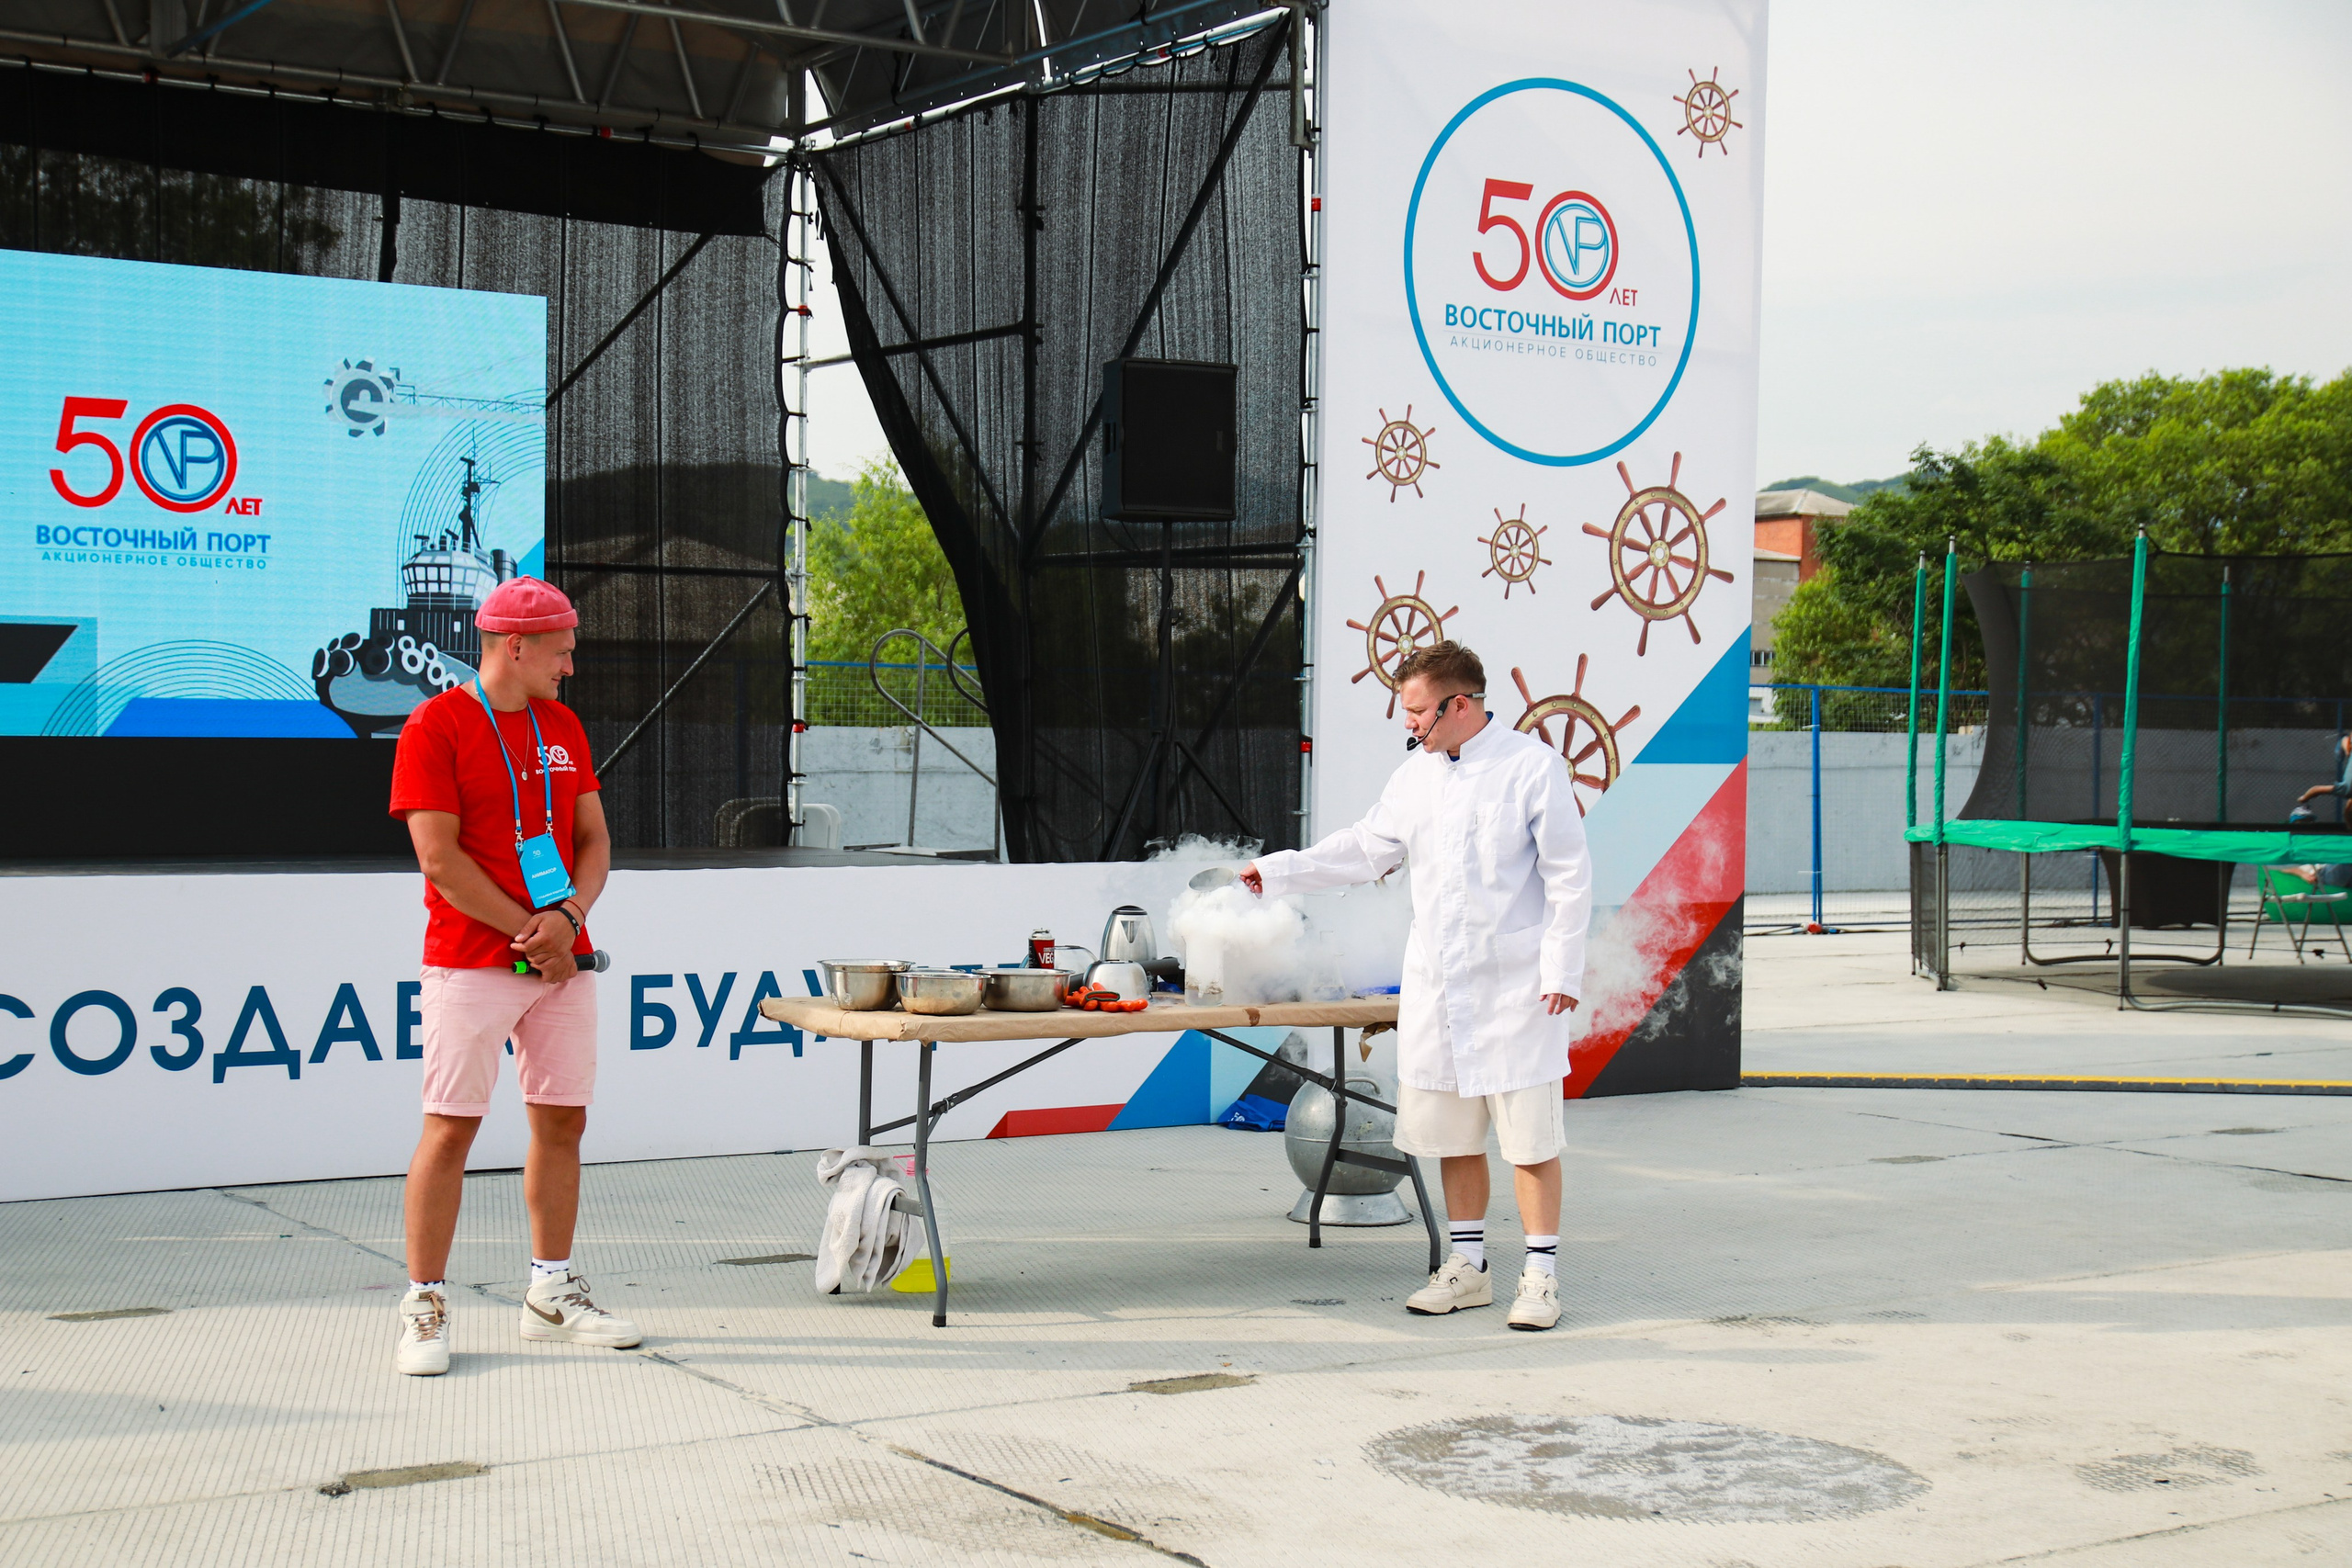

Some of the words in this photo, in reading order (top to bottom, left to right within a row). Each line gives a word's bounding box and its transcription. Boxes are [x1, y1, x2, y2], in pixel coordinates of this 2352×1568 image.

[1473, 178, 1619, 300] 50
[1610, 288, 1638, 307] ЛЕТ
[1445, 304, 1593, 341] ВОСТОЧНЫЙ
[1603, 321, 1661, 347] ПОРТ
[1450, 335, 1566, 357] АКЦИОНЕРНОЕ
[1575, 348, 1657, 367] ОБЩЕСТВО
[50, 396, 237, 513] 50
[225, 497, 263, 516] ЛЕТ
[36, 524, 198, 551] ВОСТОЧНЫЙ
[207, 532, 271, 553] ПОРТ
[41, 550, 169, 566] АКЦИОНЕРНОЕ
[177, 556, 267, 570] ОБЩЕСТВО
